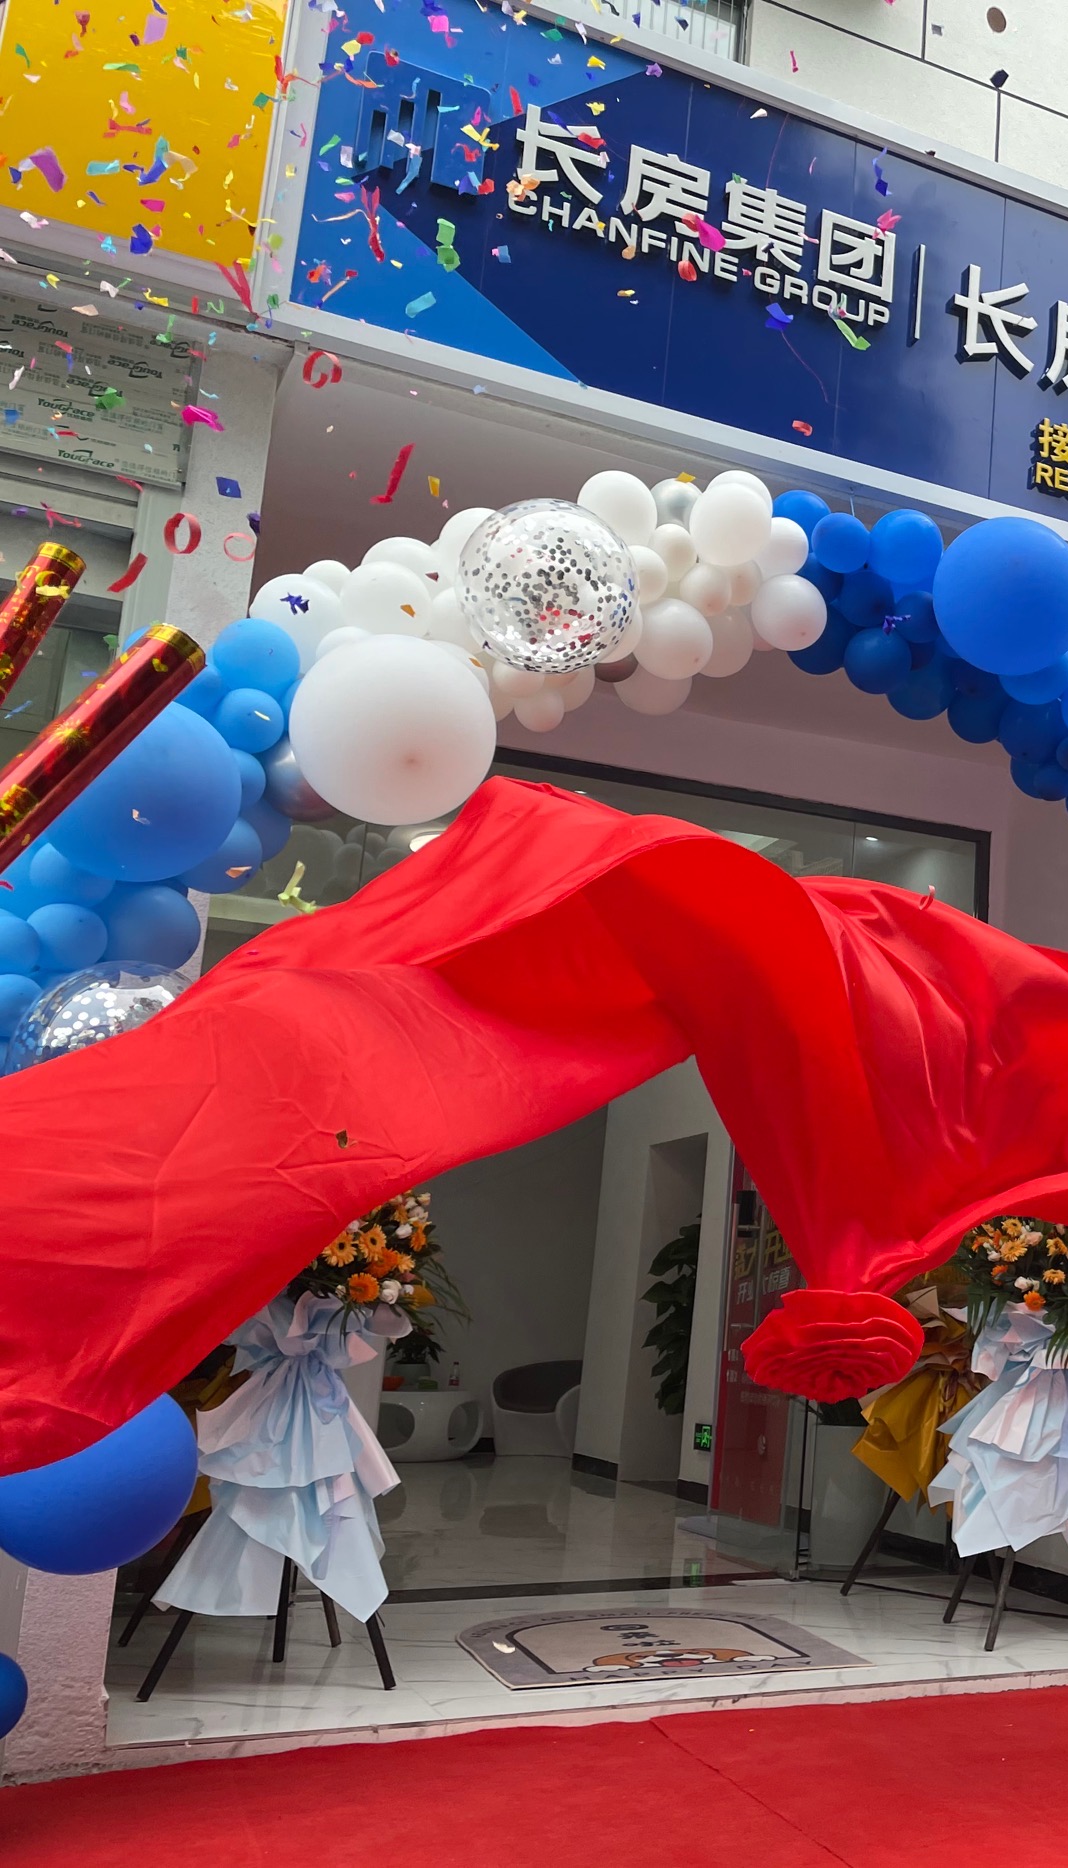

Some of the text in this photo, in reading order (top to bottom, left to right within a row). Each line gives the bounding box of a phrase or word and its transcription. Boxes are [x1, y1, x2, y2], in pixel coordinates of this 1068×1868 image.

[508, 188, 891, 328] CHANFINE GROUP
[515, 103, 897, 303] 长房集团
[569, 1660, 815, 1682] HAPPY DAY
